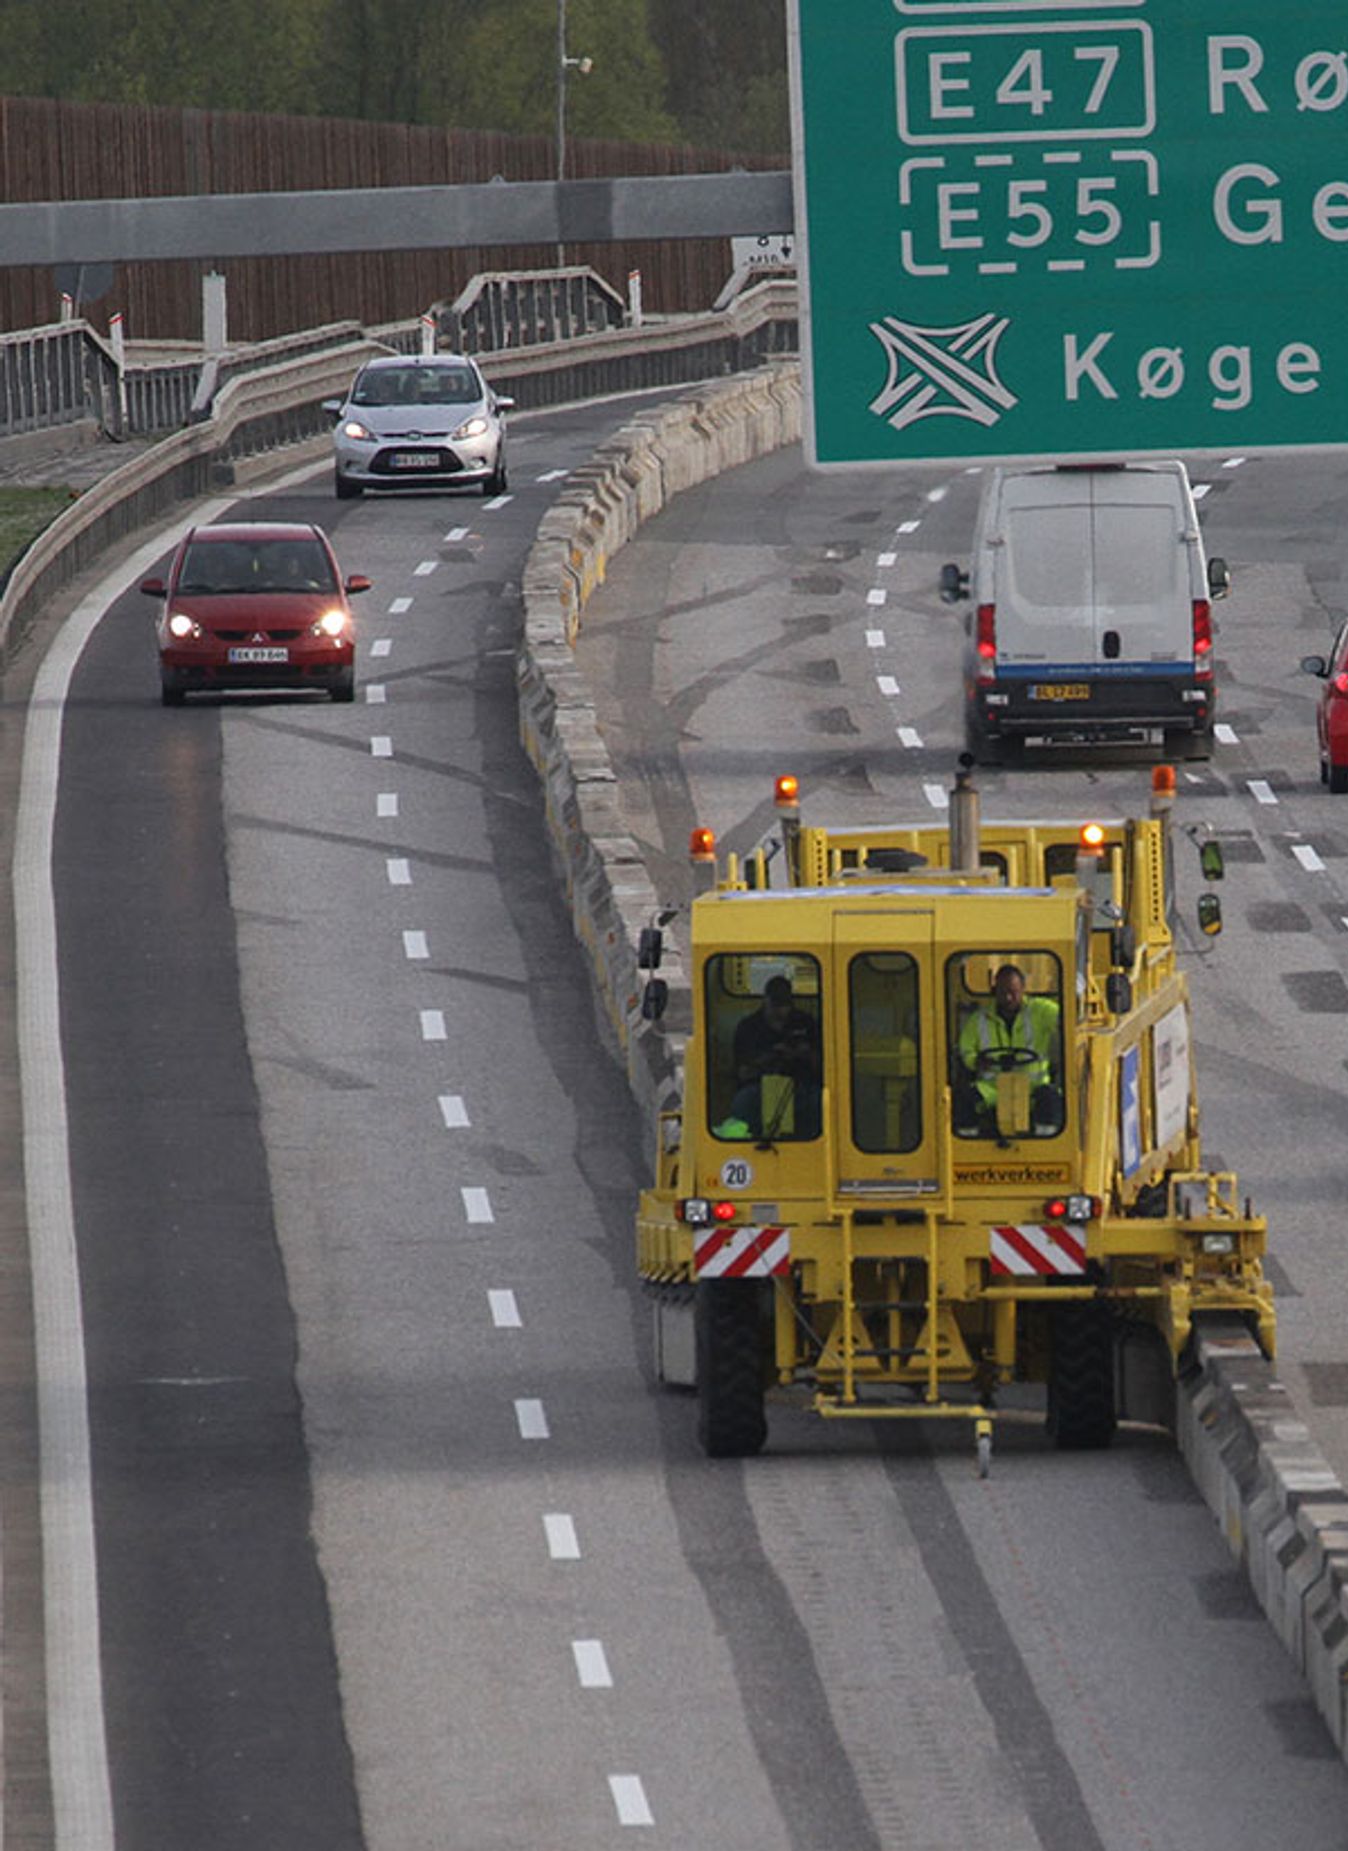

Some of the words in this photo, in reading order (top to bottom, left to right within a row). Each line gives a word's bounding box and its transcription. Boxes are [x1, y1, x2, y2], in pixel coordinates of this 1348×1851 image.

[930, 47, 1119, 119] E47
[938, 177, 1121, 249] E55
[1064, 332, 1320, 410] Køge
[726, 1163, 747, 1185] 20
[955, 1167, 1063, 1182] werkverkeer
